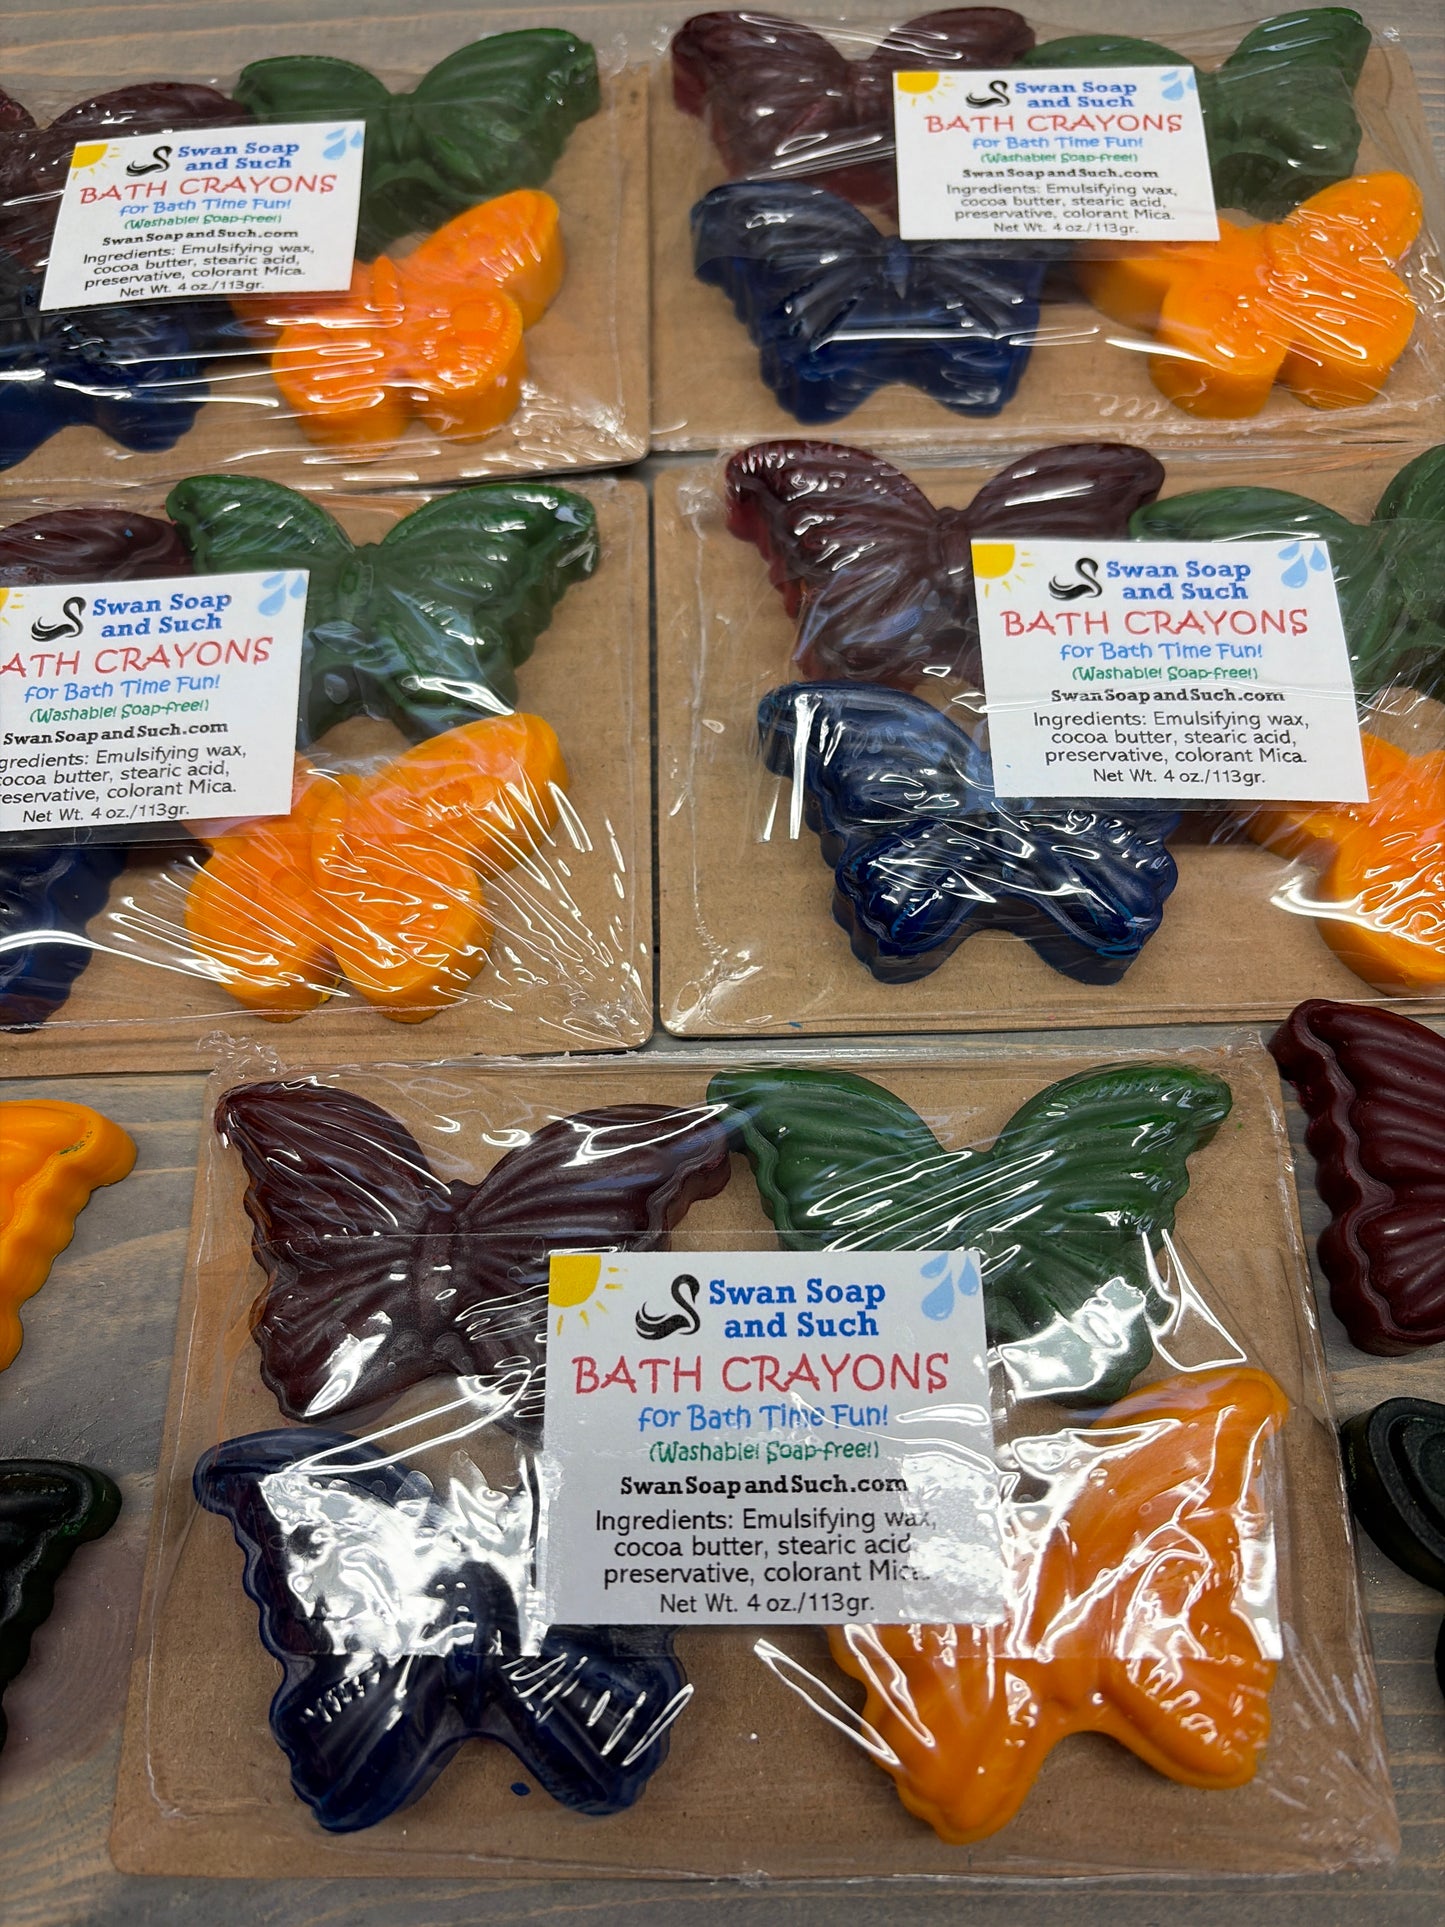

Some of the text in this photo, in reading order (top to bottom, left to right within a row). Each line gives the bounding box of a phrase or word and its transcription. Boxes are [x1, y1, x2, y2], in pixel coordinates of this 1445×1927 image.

[1015, 81, 1137, 97] Swan Soap
[1027, 95, 1134, 108] and Such
[924, 113, 1183, 133] BATH CRAYONS
[177, 142, 300, 158] Swan Soap
[972, 135, 1143, 150] for Bath Time Fun!
[185, 156, 291, 172] and Such
[962, 167, 1159, 180] SwanSoapandSuch.com
[79, 174, 337, 205] BATH CRAYONS
[946, 182, 1177, 198] Ingredients: Emulsifying wax,
[119, 198, 292, 217] for Bath Time Fun!
[960, 195, 1166, 209] cocoa butter, stearic acid,
[954, 208, 1057, 222] preservative,
[1062, 207, 1129, 219] colorant
[102, 228, 299, 247] SwanSoapandSuch.com
[993, 222, 1019, 232] Net
[1053, 223, 1061, 231] 4
[83, 242, 314, 270] Ingredients: Emulsifying wax,
[93, 254, 300, 275] cocoa butter, stearic acid,
[84, 271, 187, 290] preservative,
[191, 266, 258, 278] colorant
[119, 287, 144, 298] Net
[177, 282, 187, 291] 4
[1106, 560, 1251, 583] Swan Soap
[1122, 582, 1249, 600] and Such
[92, 593, 232, 616] Swan Soap
[100, 612, 222, 638] and Such
[999, 608, 1308, 637] BATH CRAYONS
[0, 636, 273, 678] ATH CRAYONS
[1059, 641, 1263, 661] for Bath Time Fun!
[1072, 665, 1258, 682] (Washable! Soap-free!)
[24, 674, 221, 704] for Bath Time Fun!
[1051, 688, 1285, 705] SwanSoapandSuch.com
[29, 699, 209, 724] (Washable! Soap-free!)
[1033, 710, 1309, 731] Ingredients: Emulsifying wax,
[3, 723, 228, 746] SwanSoapandSuch.com
[1051, 729, 1297, 748] cocoa butter, stearic acid,
[0, 745, 246, 774] gredients: Emulsifying wax,
[1045, 746, 1307, 766] preservative, colorant Mica.
[0, 759, 230, 787] ocoa butter, stearic acid,
[1093, 768, 1124, 782] Net
[1129, 768, 1157, 783] Wt.
[1163, 769, 1175, 783] 4
[0, 778, 237, 805] eservative, colorant Mica.
[22, 809, 53, 823] Net
[59, 807, 84, 821] Wt.
[90, 807, 102, 820] 4
[709, 1278, 886, 1311] Swan Soap
[724, 1310, 880, 1339] and Such
[571, 1352, 949, 1395] BATH CRAYONS
[638, 1402, 888, 1433] for Bath Time Fun!
[649, 1440, 760, 1464] (Washable!
[620, 1473, 908, 1500] SwanSoapandSuch.com
[596, 1508, 733, 1537] Ingredients:
[743, 1507, 876, 1535] Emulsifying
[614, 1537, 684, 1557] cocoa
[692, 1534, 769, 1559] butter,
[777, 1533, 856, 1556] stearic
[604, 1561, 755, 1591] preservative,
[763, 1560, 862, 1583] colorant
[660, 1593, 697, 1614] Net
[704, 1592, 739, 1613] Wt.
[746, 1593, 761, 1612] 4
